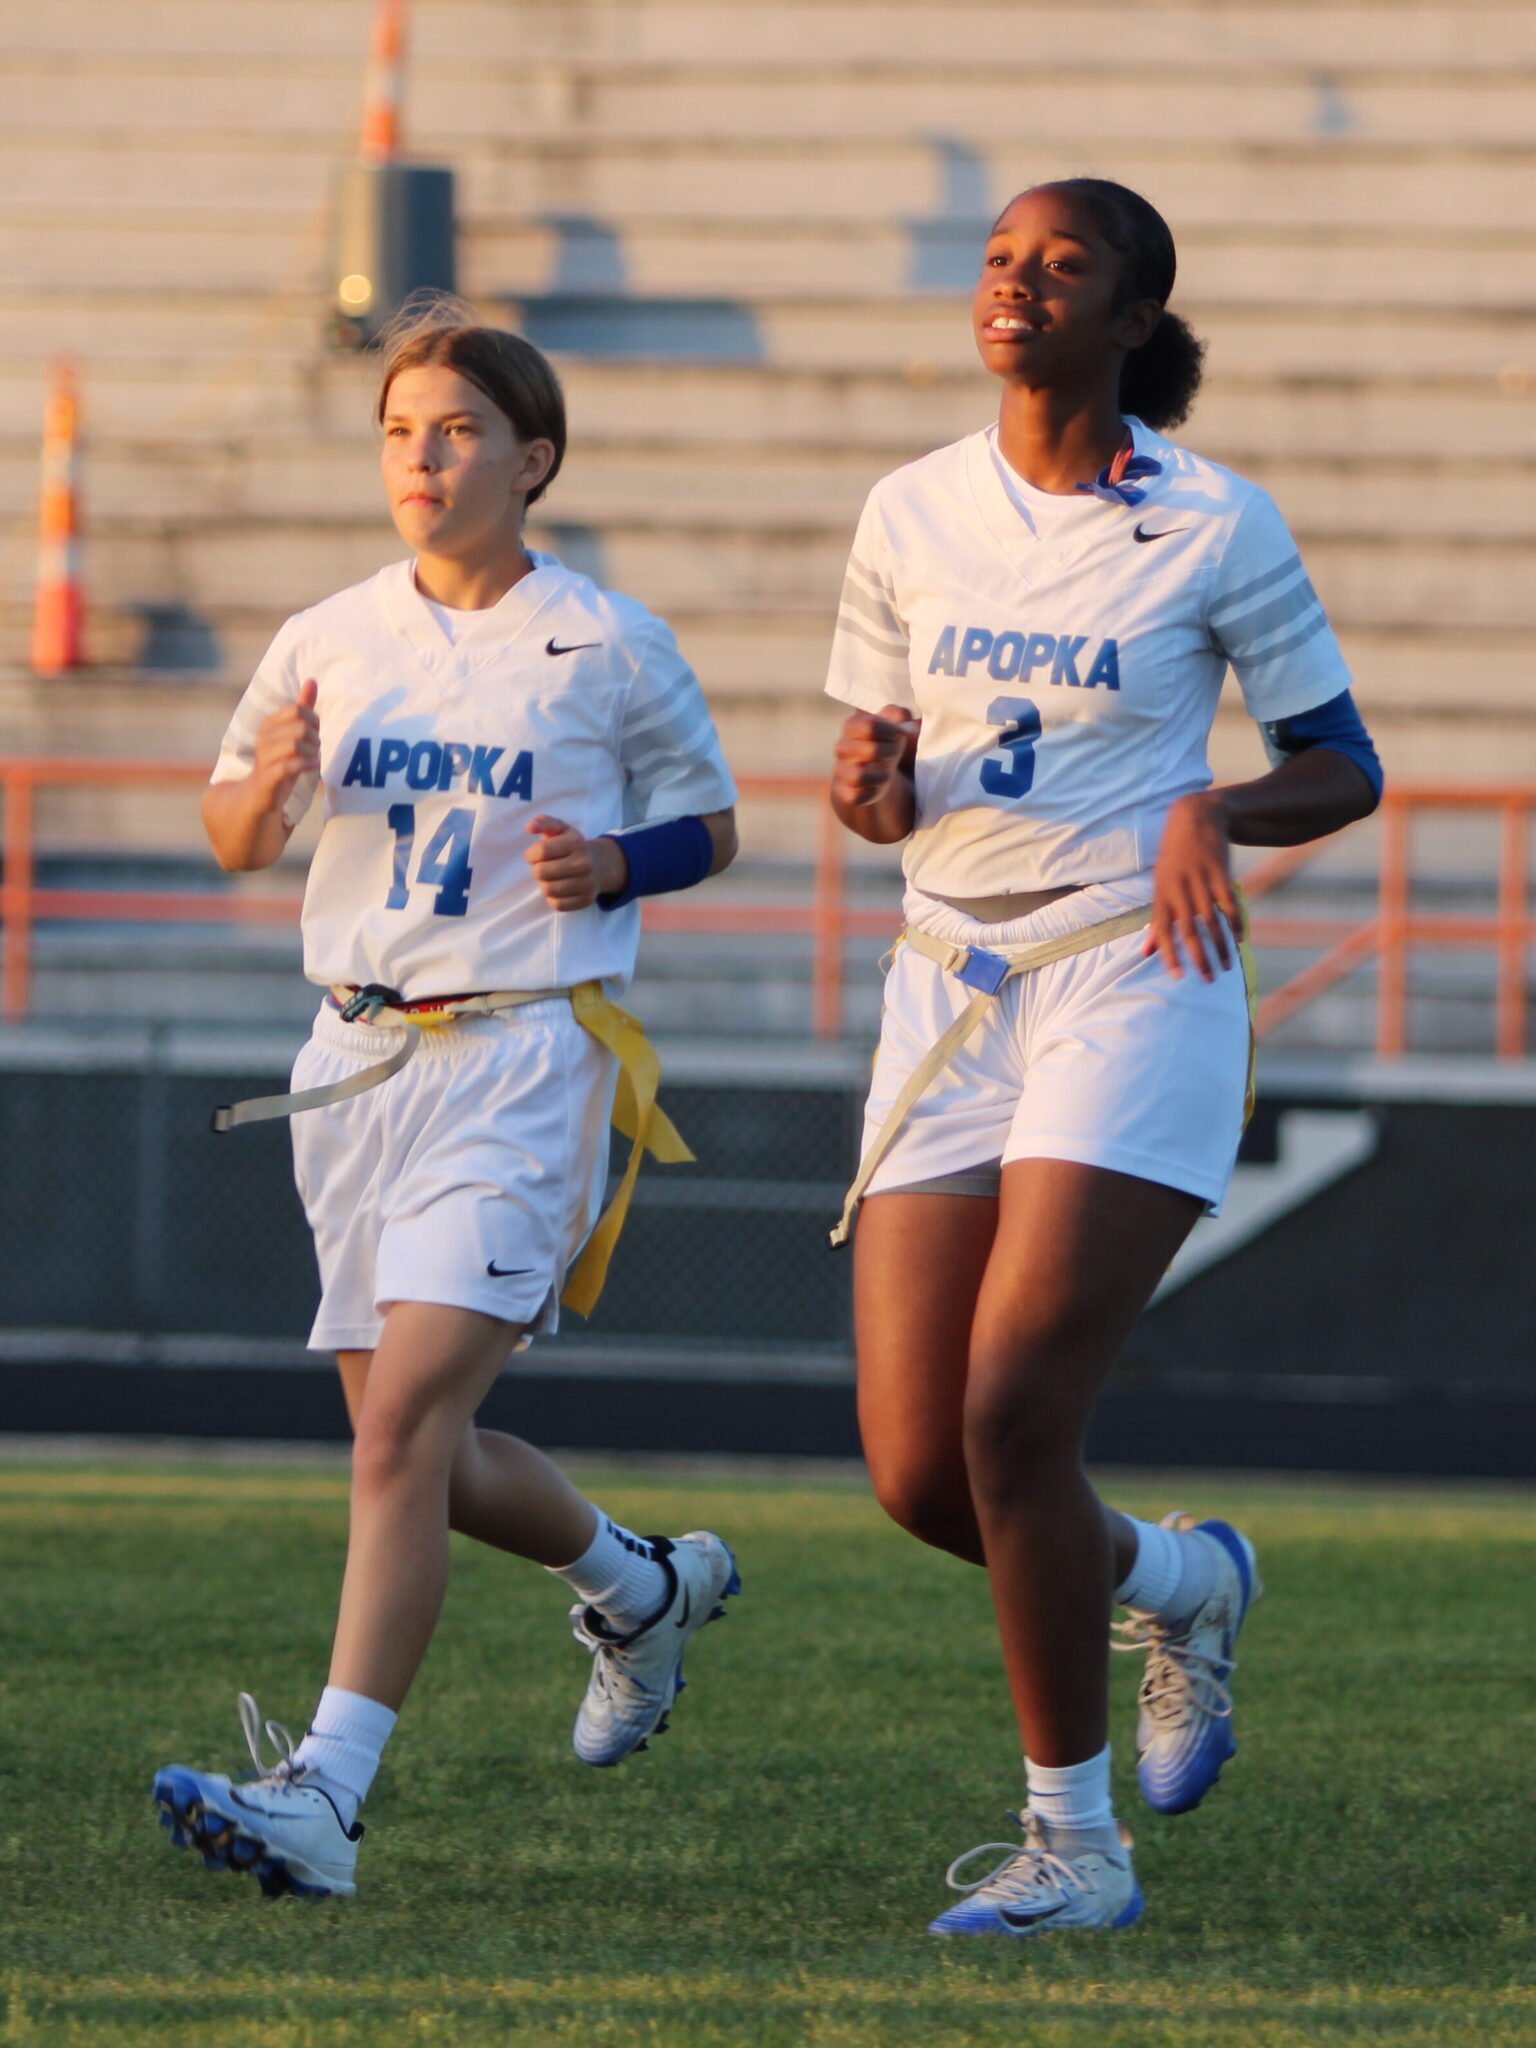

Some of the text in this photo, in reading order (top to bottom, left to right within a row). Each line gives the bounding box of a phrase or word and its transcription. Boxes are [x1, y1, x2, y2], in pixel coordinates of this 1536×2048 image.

[927, 625, 1121, 691] APOPKA
[341, 738, 534, 802] APOPKA
[979, 695, 1043, 800] 3
[383, 803, 477, 917] 14
